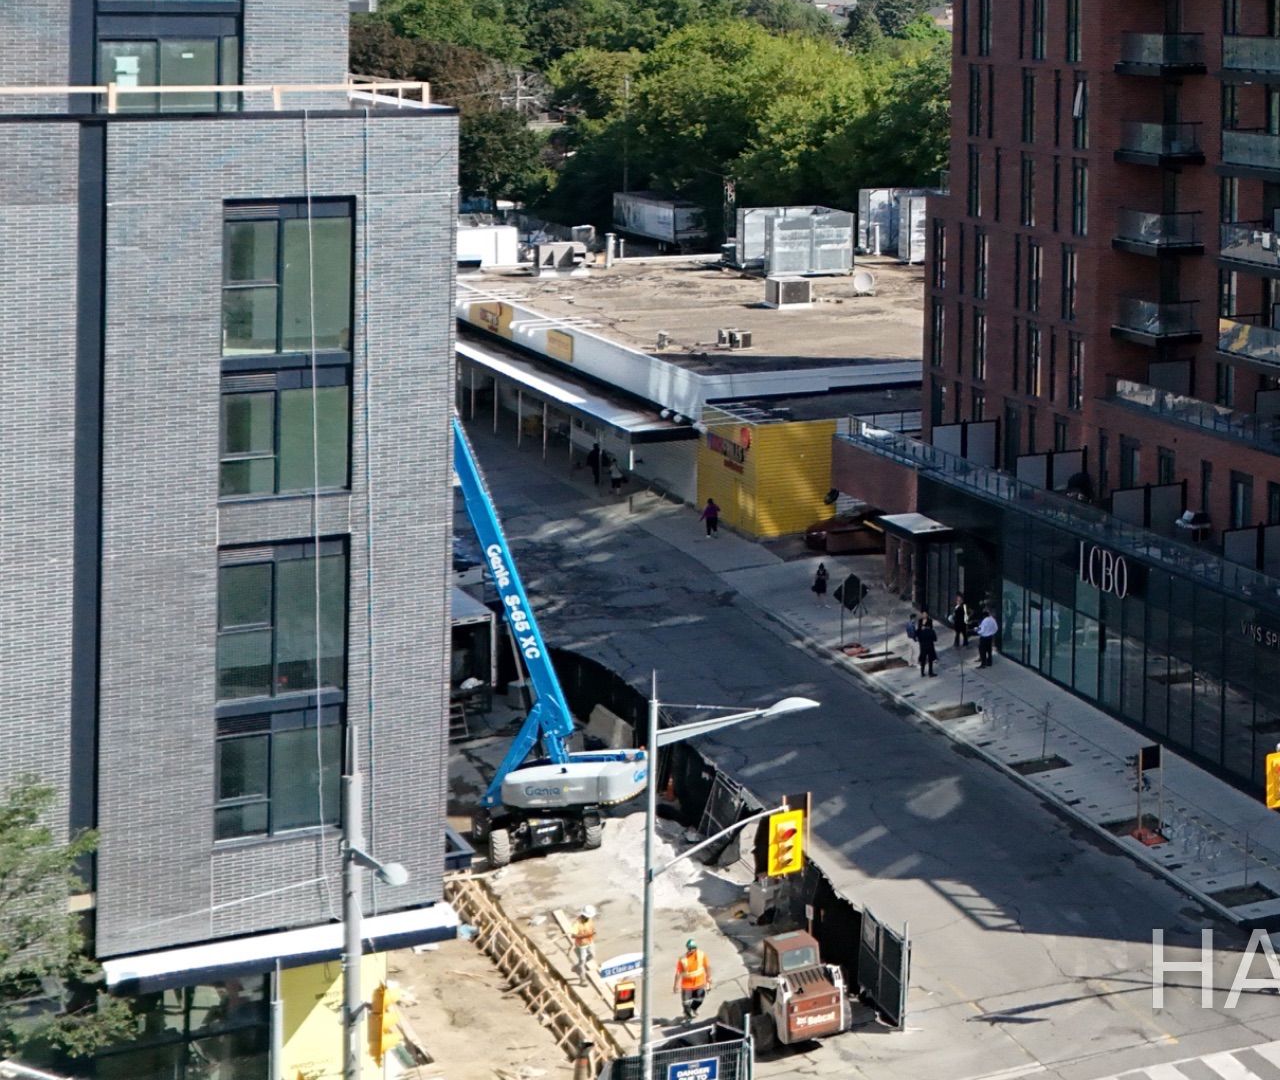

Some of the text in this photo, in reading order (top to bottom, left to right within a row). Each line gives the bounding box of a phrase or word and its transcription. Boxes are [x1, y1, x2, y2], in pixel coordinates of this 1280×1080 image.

[1079, 541, 1128, 600] LCBO
[486, 543, 511, 588] Genie
[520, 635, 541, 660] XC
[1241, 620, 1262, 643] VINS
[525, 785, 561, 797] Genie
[808, 1011, 836, 1025] Bobcat
[677, 1066, 710, 1078] DANGER
